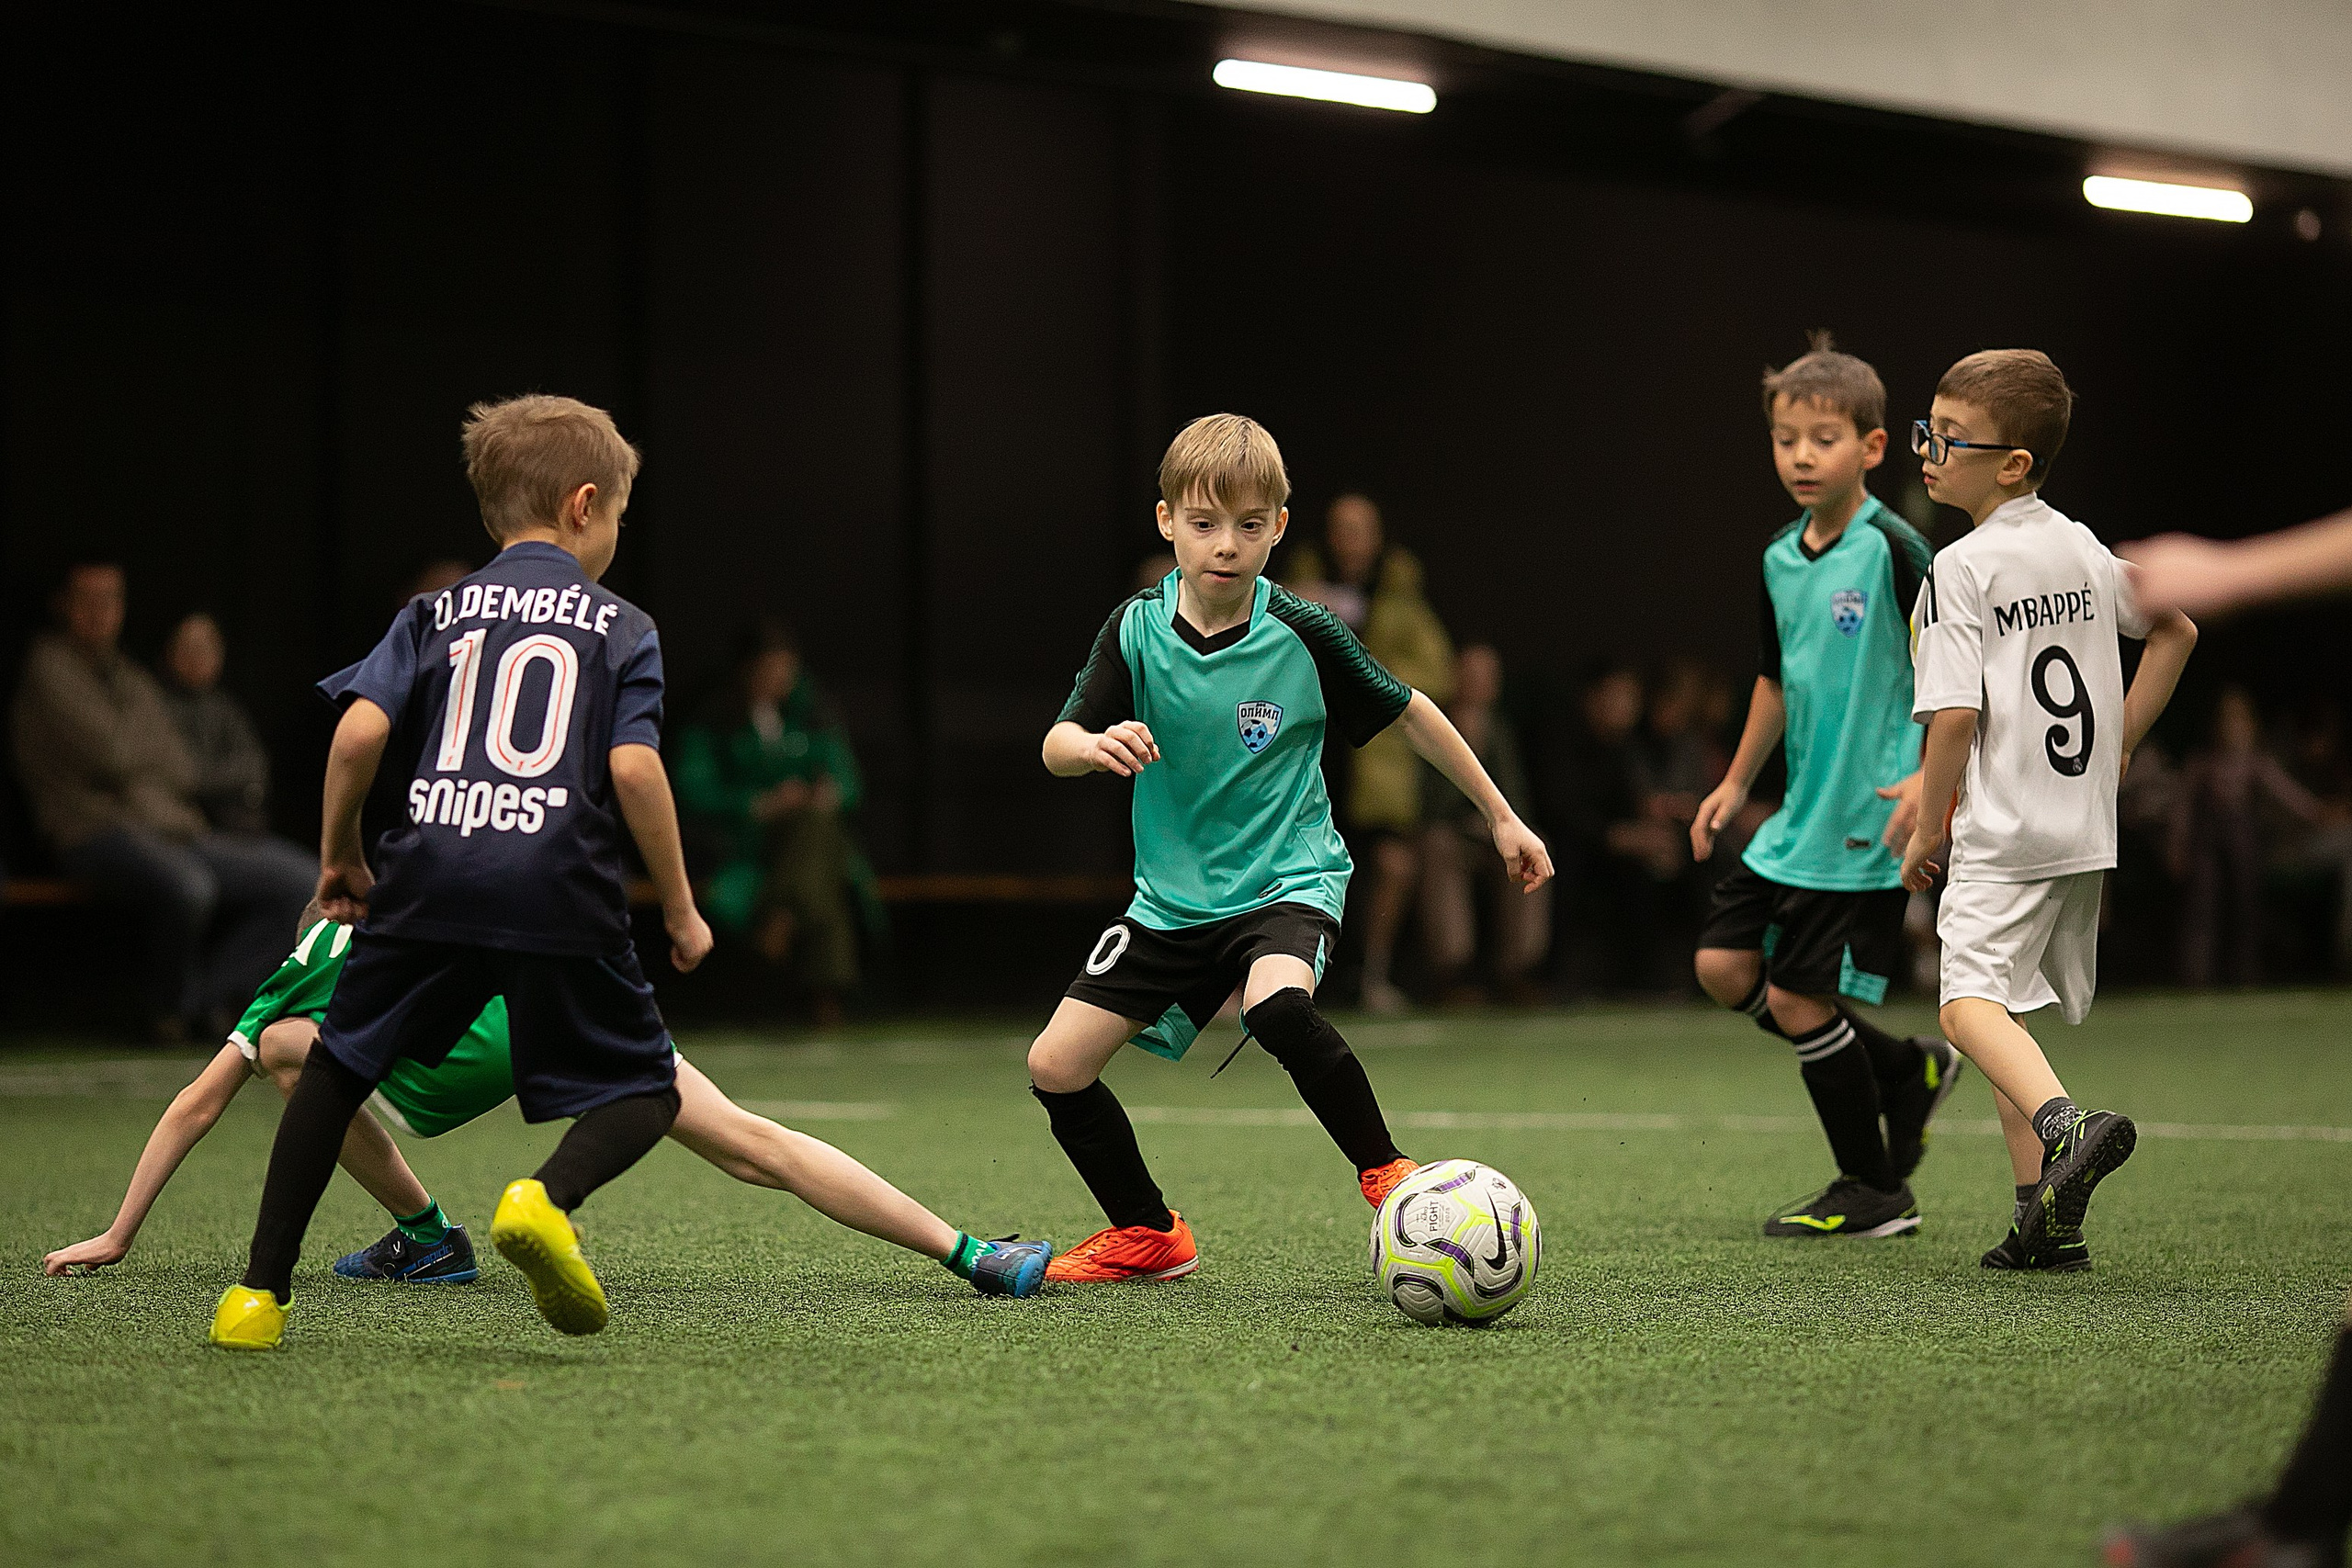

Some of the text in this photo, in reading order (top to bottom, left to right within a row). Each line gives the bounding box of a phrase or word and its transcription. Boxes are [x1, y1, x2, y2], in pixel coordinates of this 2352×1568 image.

[435, 583, 618, 636] O.DEMBÉLÉ
[1993, 581, 2095, 637] MBAPPÉ
[435, 628, 578, 778] 10
[2030, 645, 2095, 777] 9
[409, 778, 547, 837] snipes
[1086, 924, 1131, 976] 0
[1430, 1201, 1439, 1232] FIGHT
